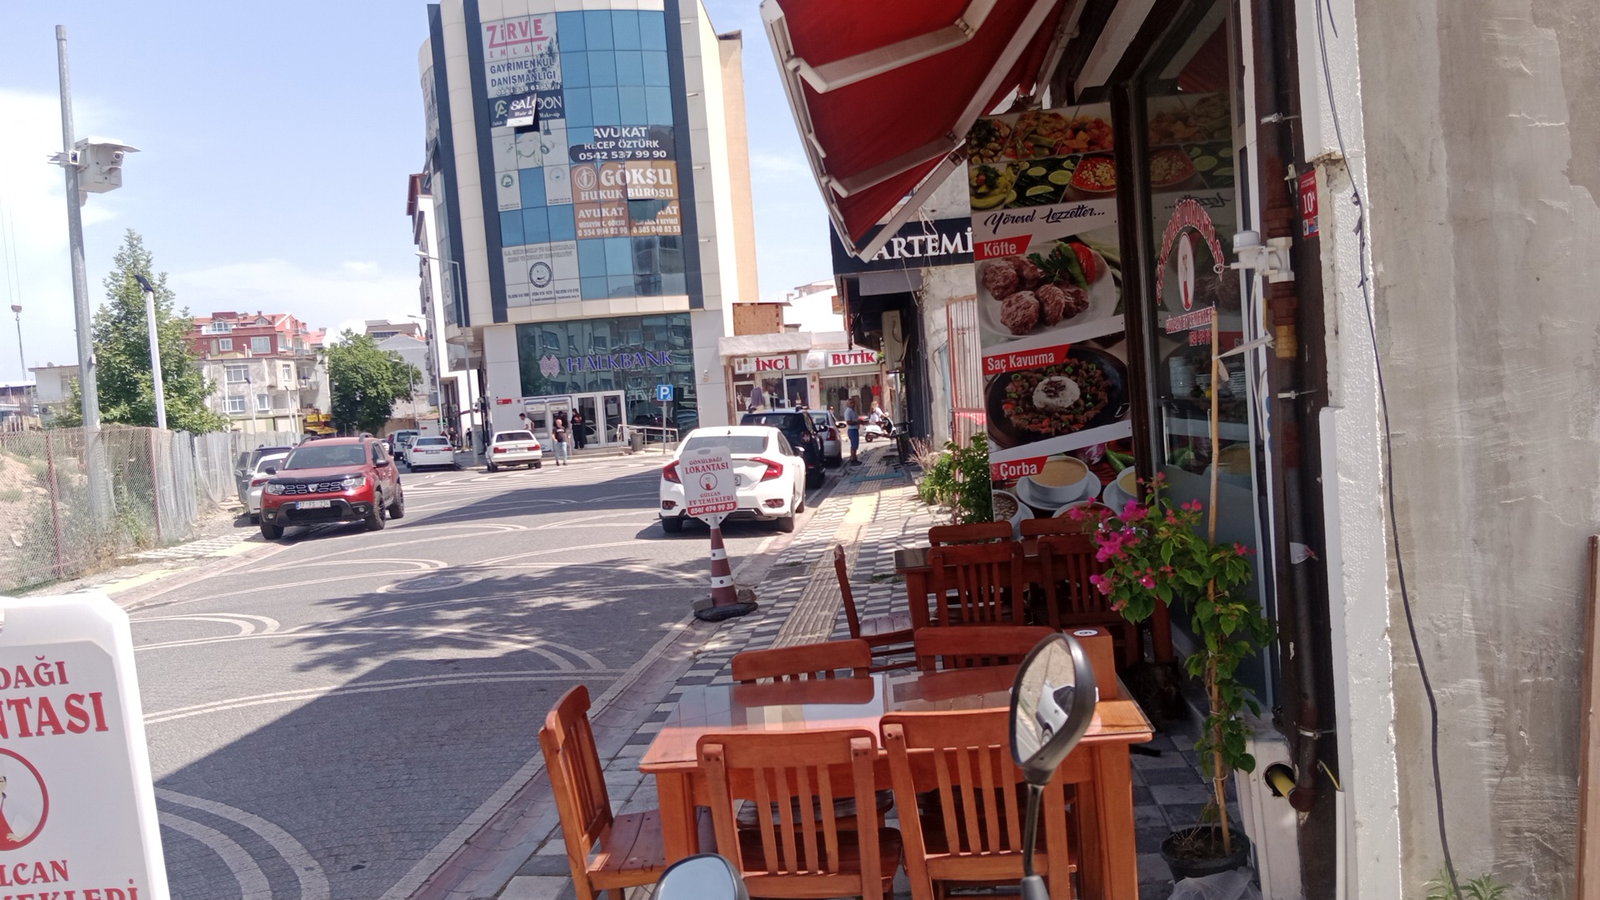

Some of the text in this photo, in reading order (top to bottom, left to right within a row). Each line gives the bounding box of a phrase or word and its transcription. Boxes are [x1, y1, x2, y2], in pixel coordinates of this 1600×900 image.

[510, 96, 562, 110] SALOON
[593, 126, 647, 138] AVUKAT
[618, 138, 660, 149] ÖZTÜRK
[578, 150, 667, 161] 0542 537 99 90
[601, 163, 673, 187] GÖKSU
[580, 189, 624, 201] HUKUK
[627, 187, 674, 199] BÜROSU
[578, 207, 625, 219] AVUKAT
[983, 209, 1037, 235] Yöresel
[983, 240, 1017, 257] Köfte
[567, 350, 673, 373] HALKBANK
[755, 355, 790, 372] İNCİ
[831, 350, 877, 366] BUTİK
[987, 352, 1055, 373] Saç Kavurma
[660, 387, 671, 400] P
[684, 462, 729, 475] LOKANTASI
[1000, 462, 1038, 480] Çorba
